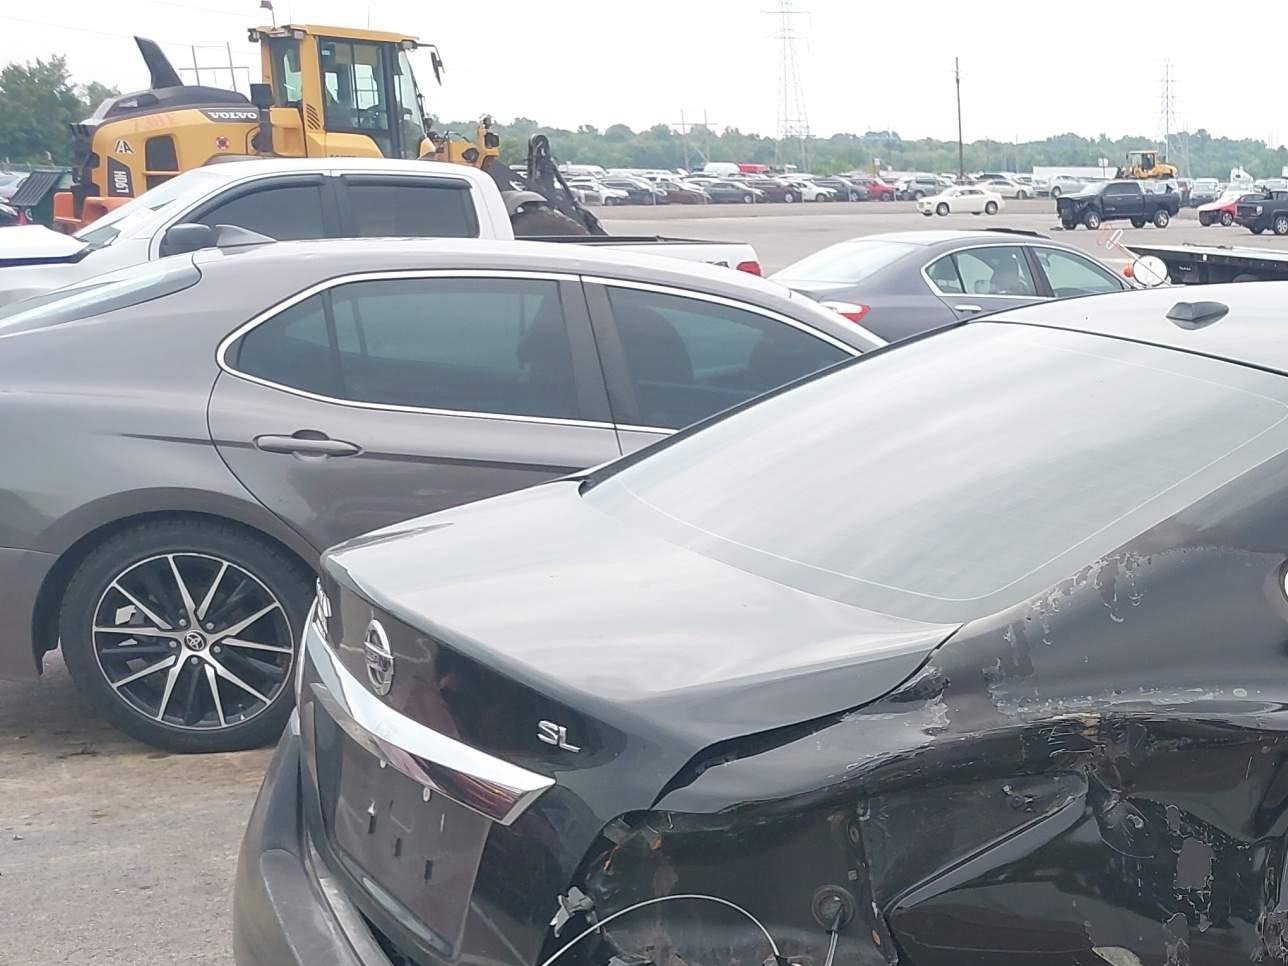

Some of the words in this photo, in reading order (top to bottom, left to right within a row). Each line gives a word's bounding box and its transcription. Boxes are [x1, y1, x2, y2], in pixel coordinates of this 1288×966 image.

[207, 111, 257, 119] VOLVO
[113, 170, 130, 193] L90H
[537, 719, 580, 752] SL
